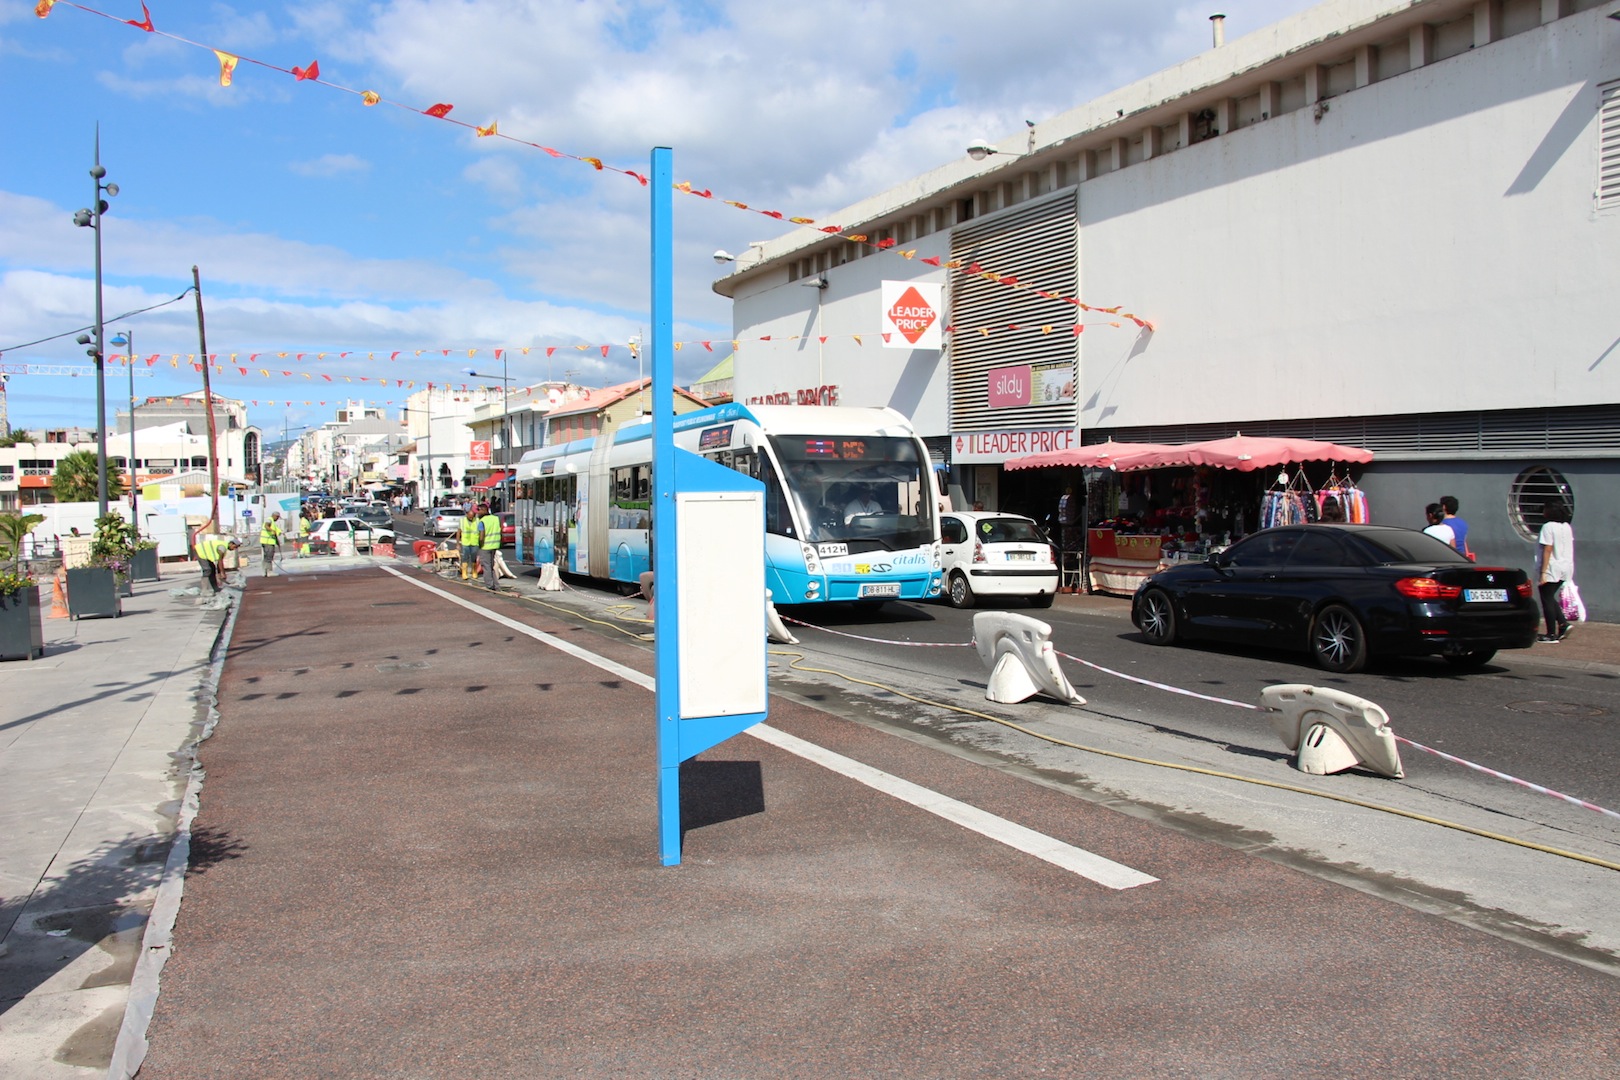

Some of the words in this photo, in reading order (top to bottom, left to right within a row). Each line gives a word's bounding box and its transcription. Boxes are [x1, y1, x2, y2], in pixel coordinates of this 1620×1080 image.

[890, 306, 934, 318] LEADER
[896, 319, 928, 330] PRICE
[996, 374, 1023, 399] sildy
[976, 432, 1027, 454] LEADER
[1031, 430, 1074, 453] PRICE
[893, 553, 926, 565] citalis
